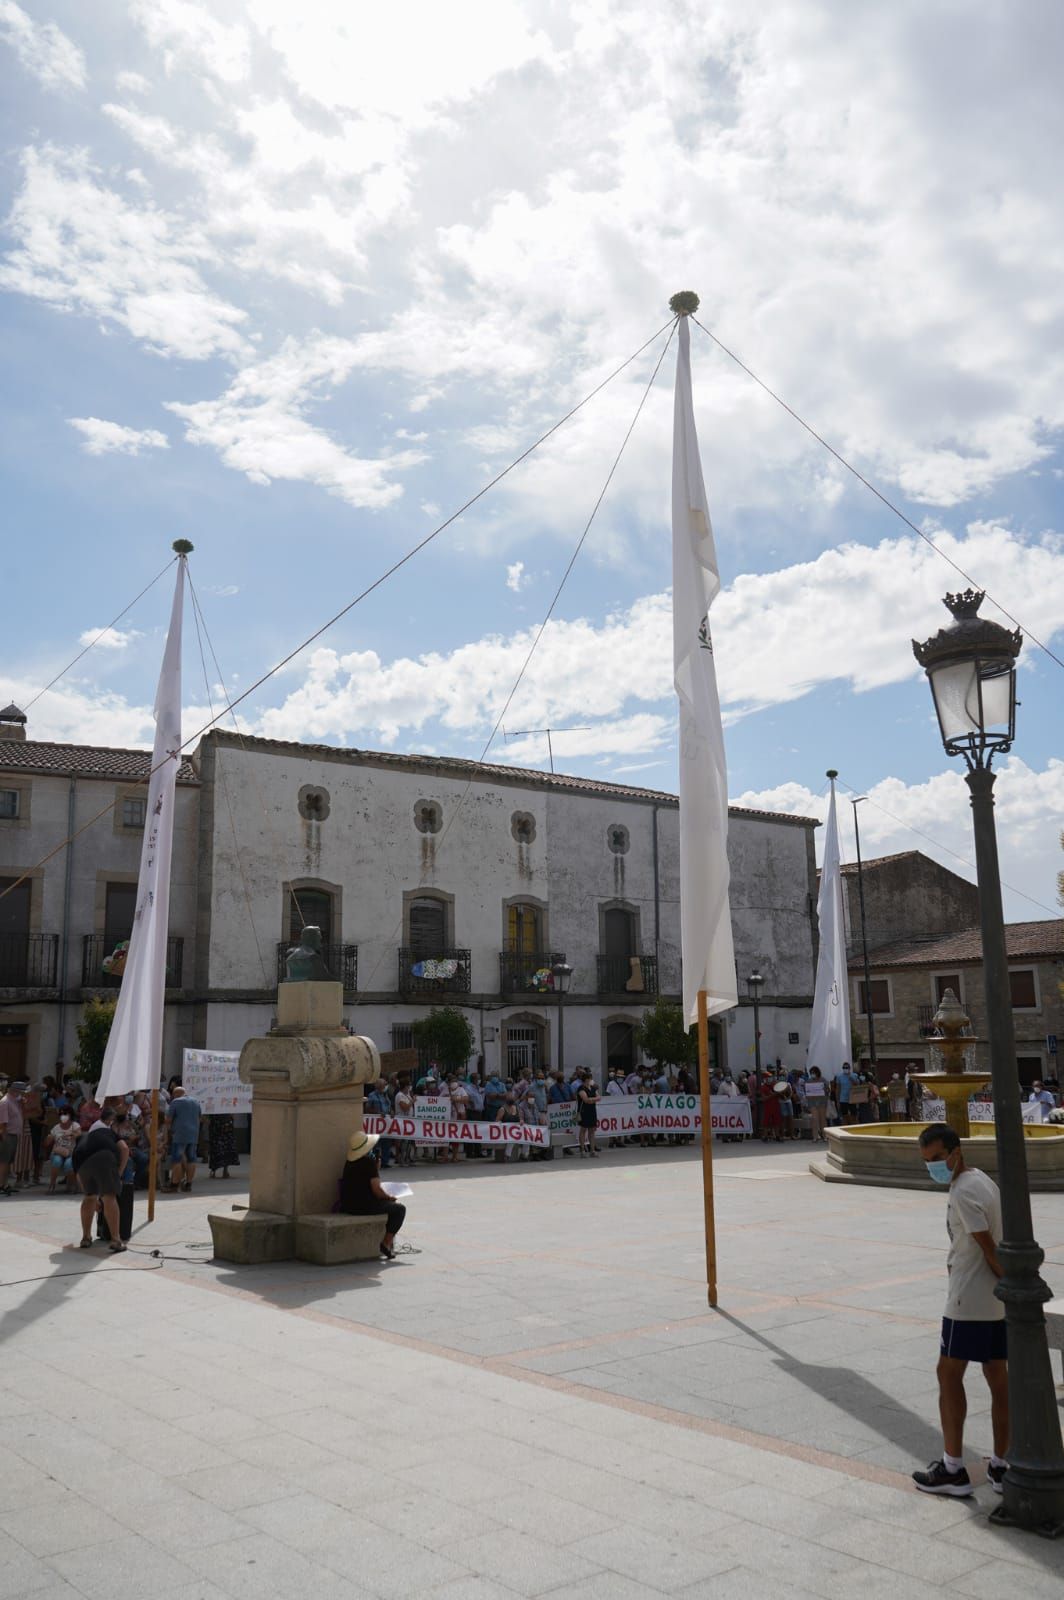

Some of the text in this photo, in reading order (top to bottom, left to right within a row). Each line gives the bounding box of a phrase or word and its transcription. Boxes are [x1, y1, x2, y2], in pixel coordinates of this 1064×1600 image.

[637, 1096, 696, 1109] SAYAGO
[549, 1110, 576, 1119] SANIDA
[549, 1119, 577, 1129] DIGN
[621, 1116, 635, 1130] LA
[637, 1115, 690, 1128] SANIDAD
[694, 1115, 744, 1128] PBLICA
[423, 1121, 482, 1140] RURAL
[489, 1125, 544, 1143] DIGNA
